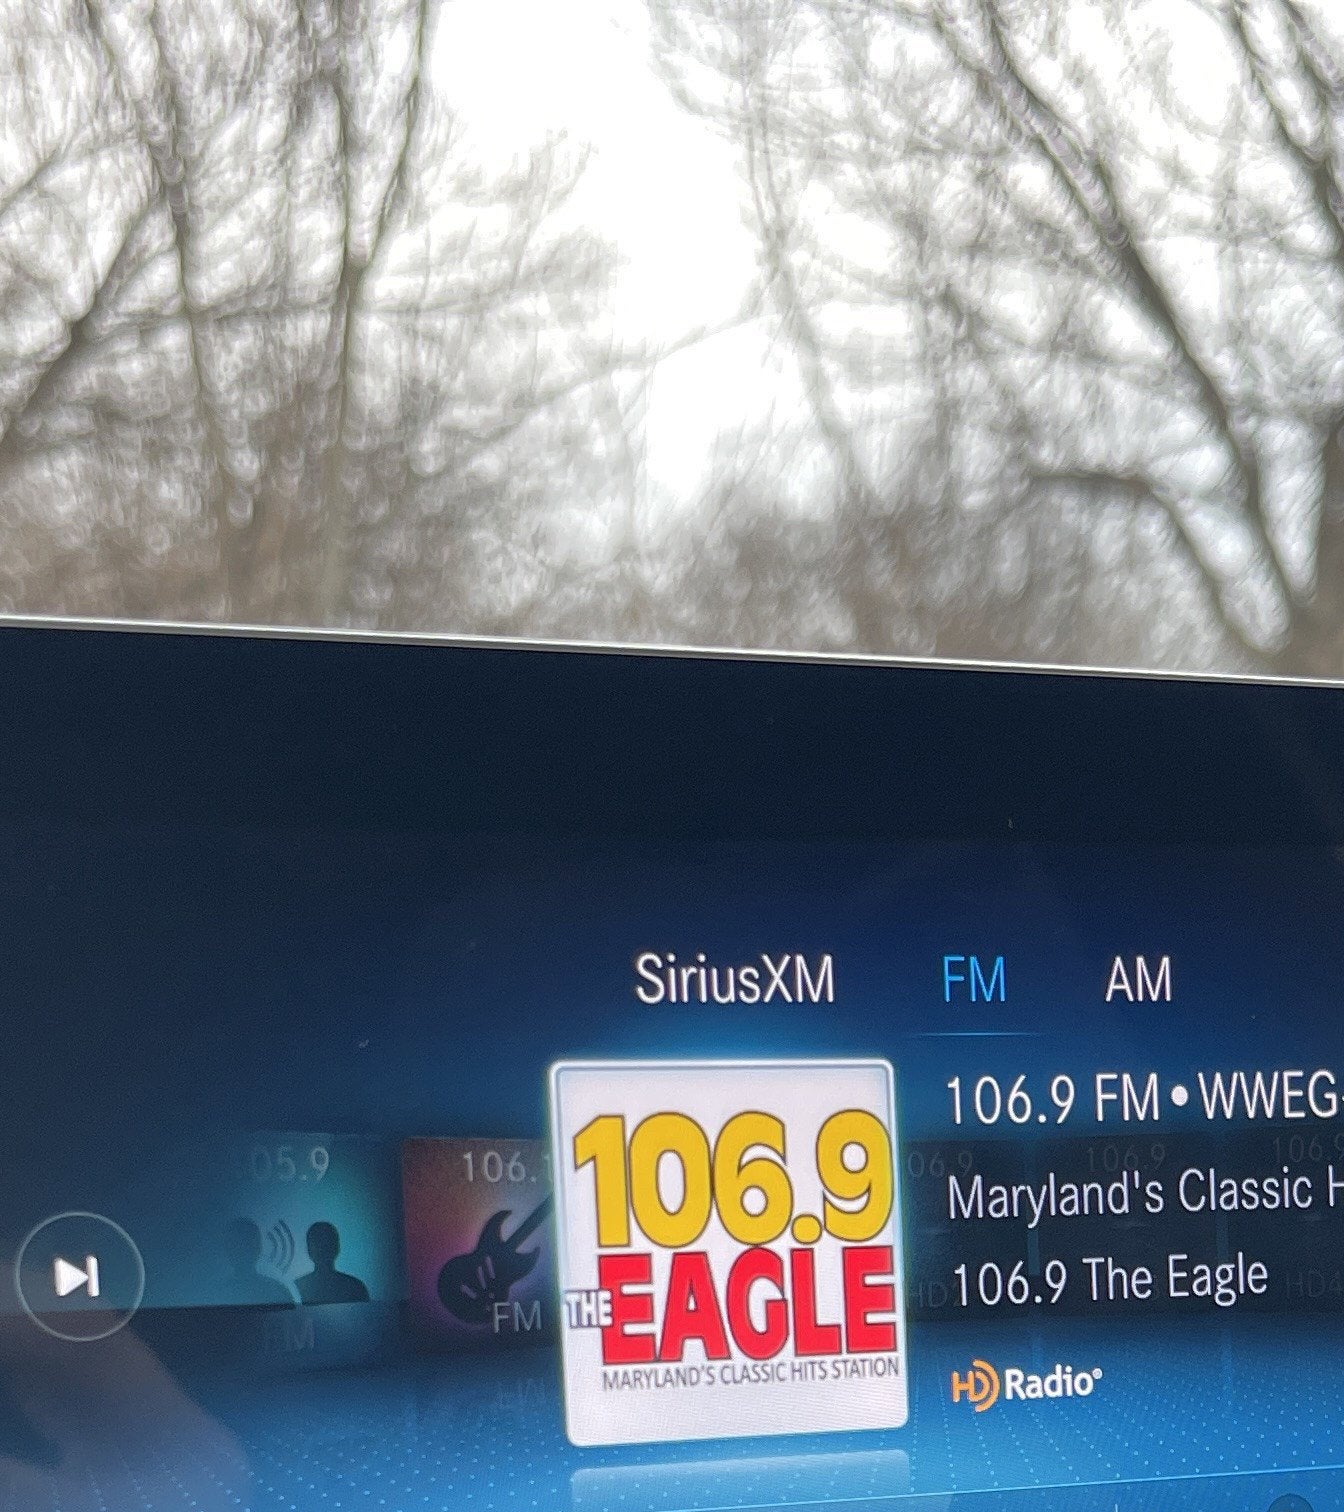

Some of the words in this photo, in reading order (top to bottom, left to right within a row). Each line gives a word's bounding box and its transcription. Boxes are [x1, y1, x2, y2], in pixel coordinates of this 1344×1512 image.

[635, 952, 835, 1004] SiriusXM
[943, 955, 1007, 1002] FM
[1105, 955, 1172, 1002] AM
[947, 1075, 1075, 1124] 106.9
[573, 1109, 894, 1249] 106.9
[948, 1173, 1164, 1229] Maryland's
[1179, 1167, 1313, 1213] Classic
[565, 1289, 613, 1329] THE
[598, 1245, 898, 1365] EAGLE
[955, 1261, 1067, 1308] 106.9
[1083, 1256, 1153, 1300] The
[1169, 1252, 1269, 1307] Eagle
[492, 1301, 542, 1334] FM
[602, 1364, 715, 1391] MARYLAND'S
[720, 1360, 787, 1385] CLASSIC
[791, 1358, 827, 1382] HITS
[830, 1356, 900, 1380] STATION
